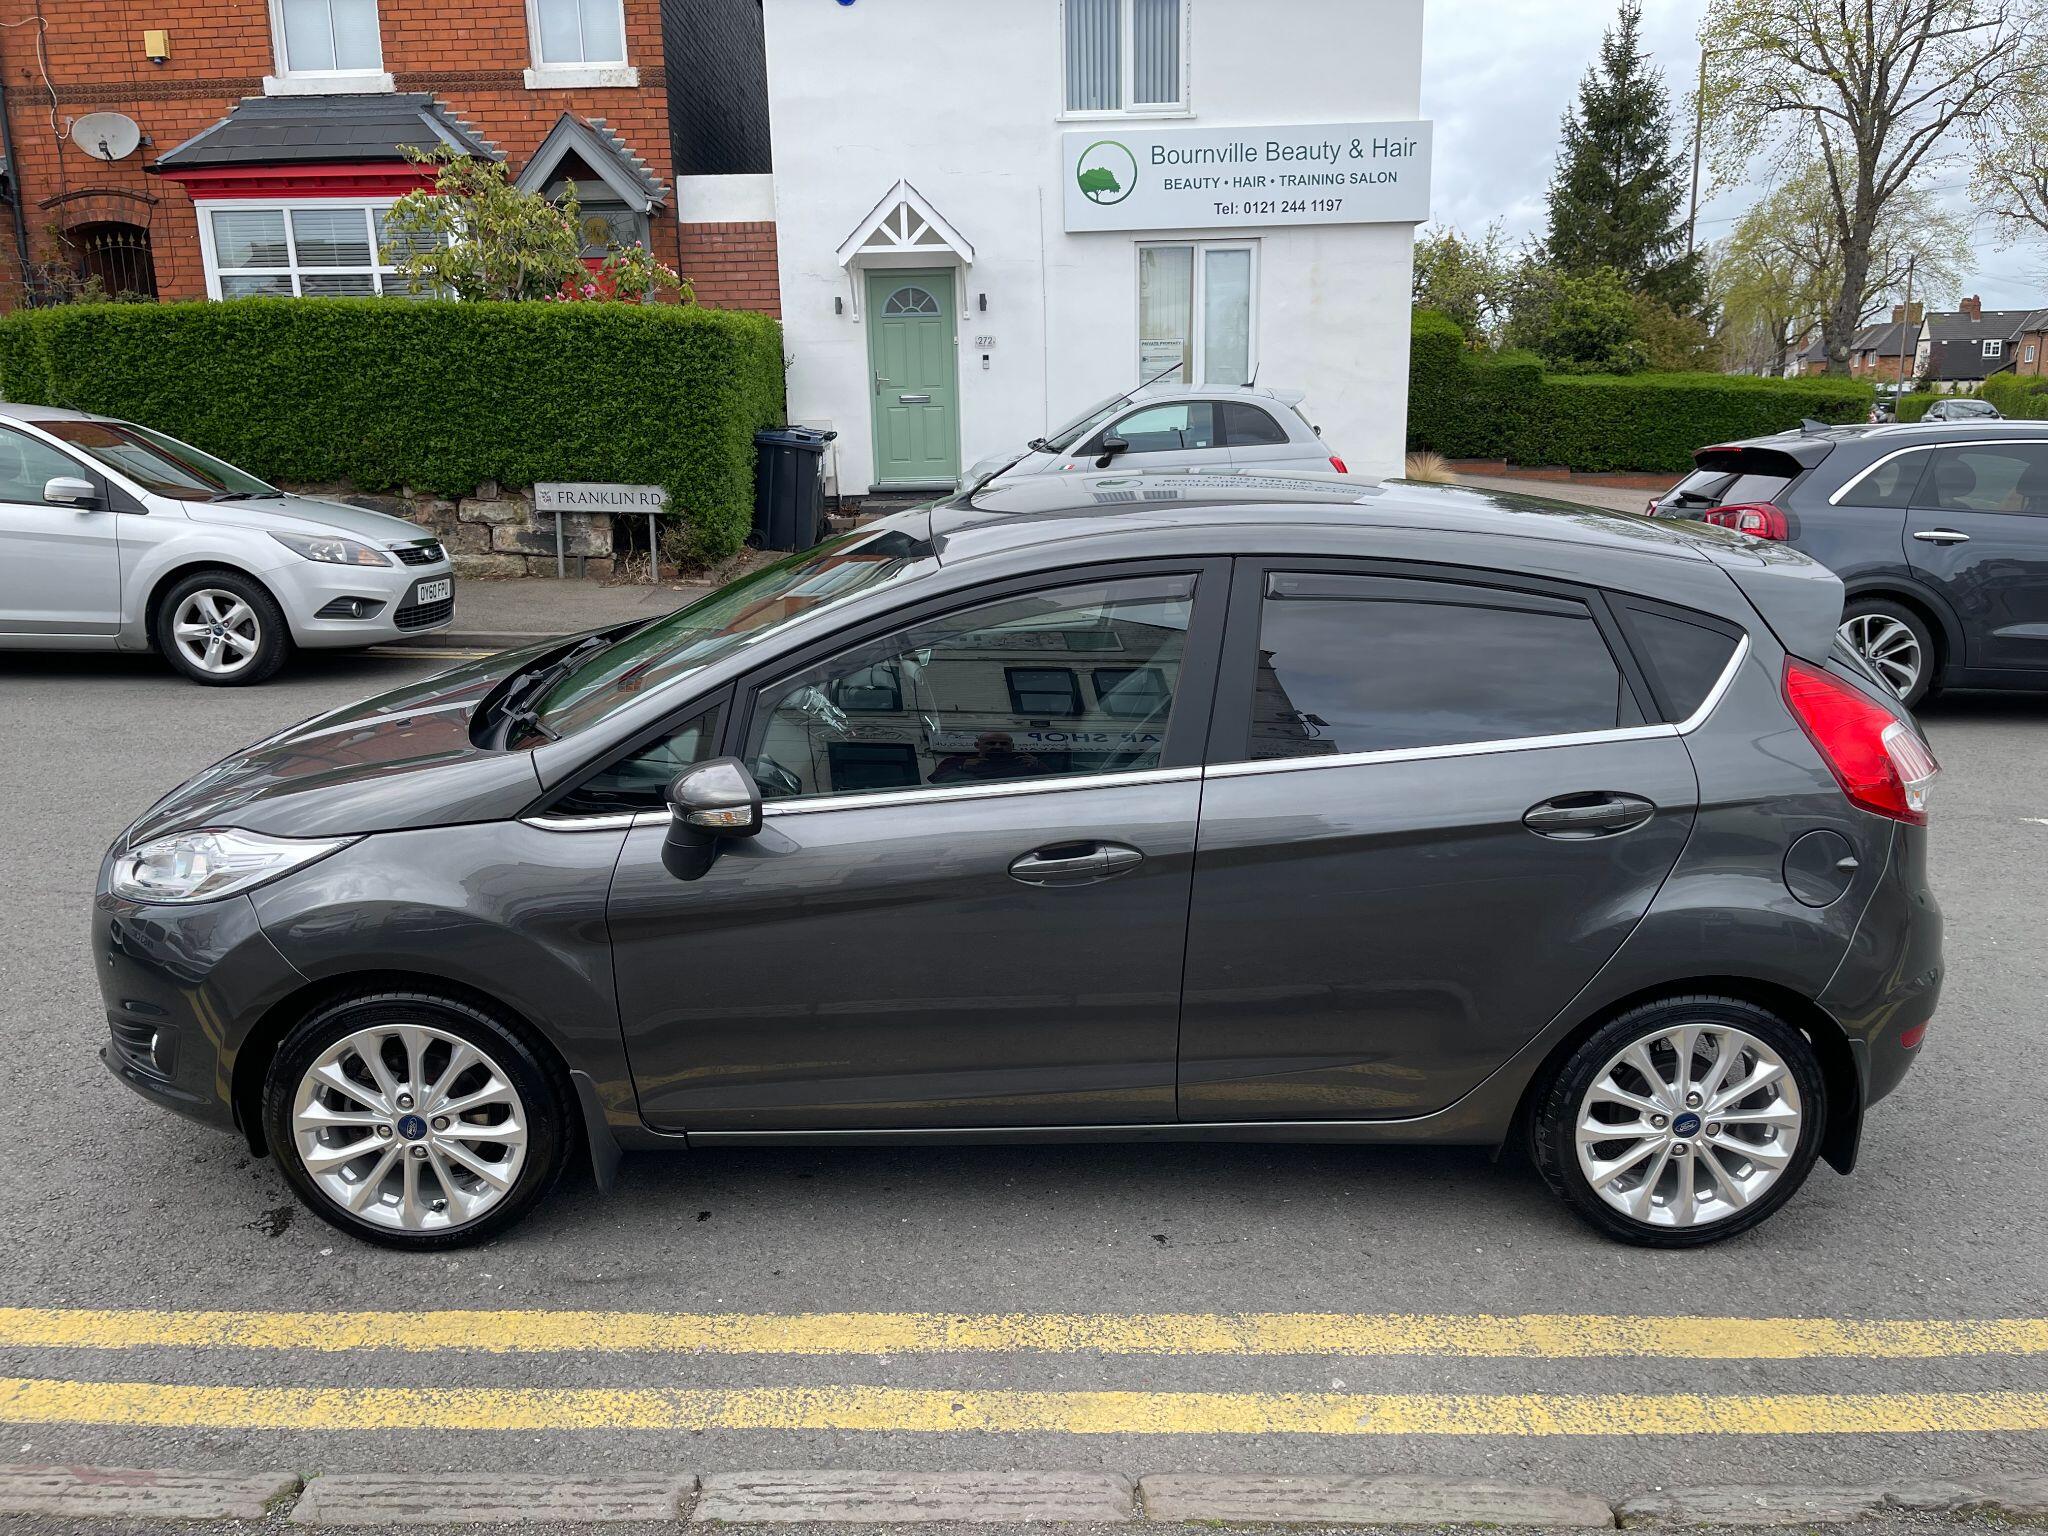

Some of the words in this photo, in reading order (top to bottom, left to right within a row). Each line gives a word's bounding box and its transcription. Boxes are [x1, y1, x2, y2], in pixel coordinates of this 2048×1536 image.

[1151, 142, 1258, 165] Bournville
[1266, 140, 1342, 165] Beauty
[1348, 138, 1364, 159] &
[1372, 136, 1418, 158] Hair
[1164, 176, 1221, 190] BEAUTY
[1233, 175, 1266, 188] HAIR
[1279, 173, 1345, 187] TRAINING
[1349, 171, 1398, 184] SALON
[1214, 202, 1239, 215] Tel:
[1243, 201, 1275, 214] 0121
[1281, 200, 1306, 213] 244
[1311, 198, 1343, 212] 1197
[977, 336, 993, 345] 272
[557, 491, 635, 505] FRANKLIN
[640, 492, 661, 506] RD
